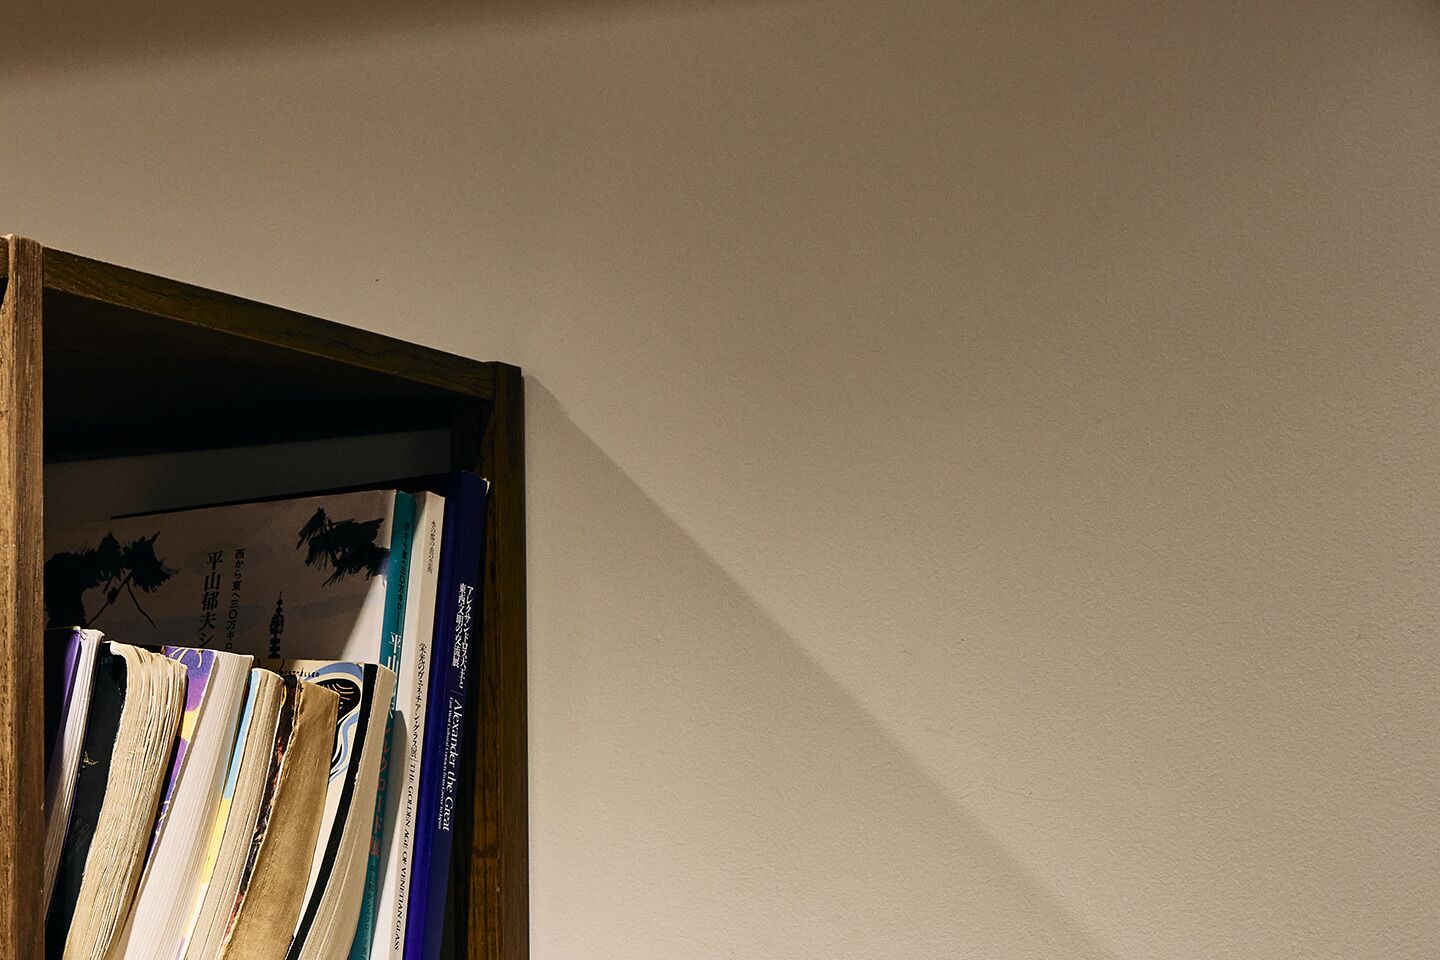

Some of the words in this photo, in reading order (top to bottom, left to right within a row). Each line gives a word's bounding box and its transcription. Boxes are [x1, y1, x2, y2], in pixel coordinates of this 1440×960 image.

[447, 697, 464, 768] Alexander
[409, 763, 417, 782] THE
[446, 768, 457, 793] the
[405, 785, 415, 827] GOLDEN
[442, 794, 455, 832] Great
[403, 828, 411, 848] AGE
[396, 866, 408, 917] VENETIAN
[394, 918, 403, 951] GLASS
